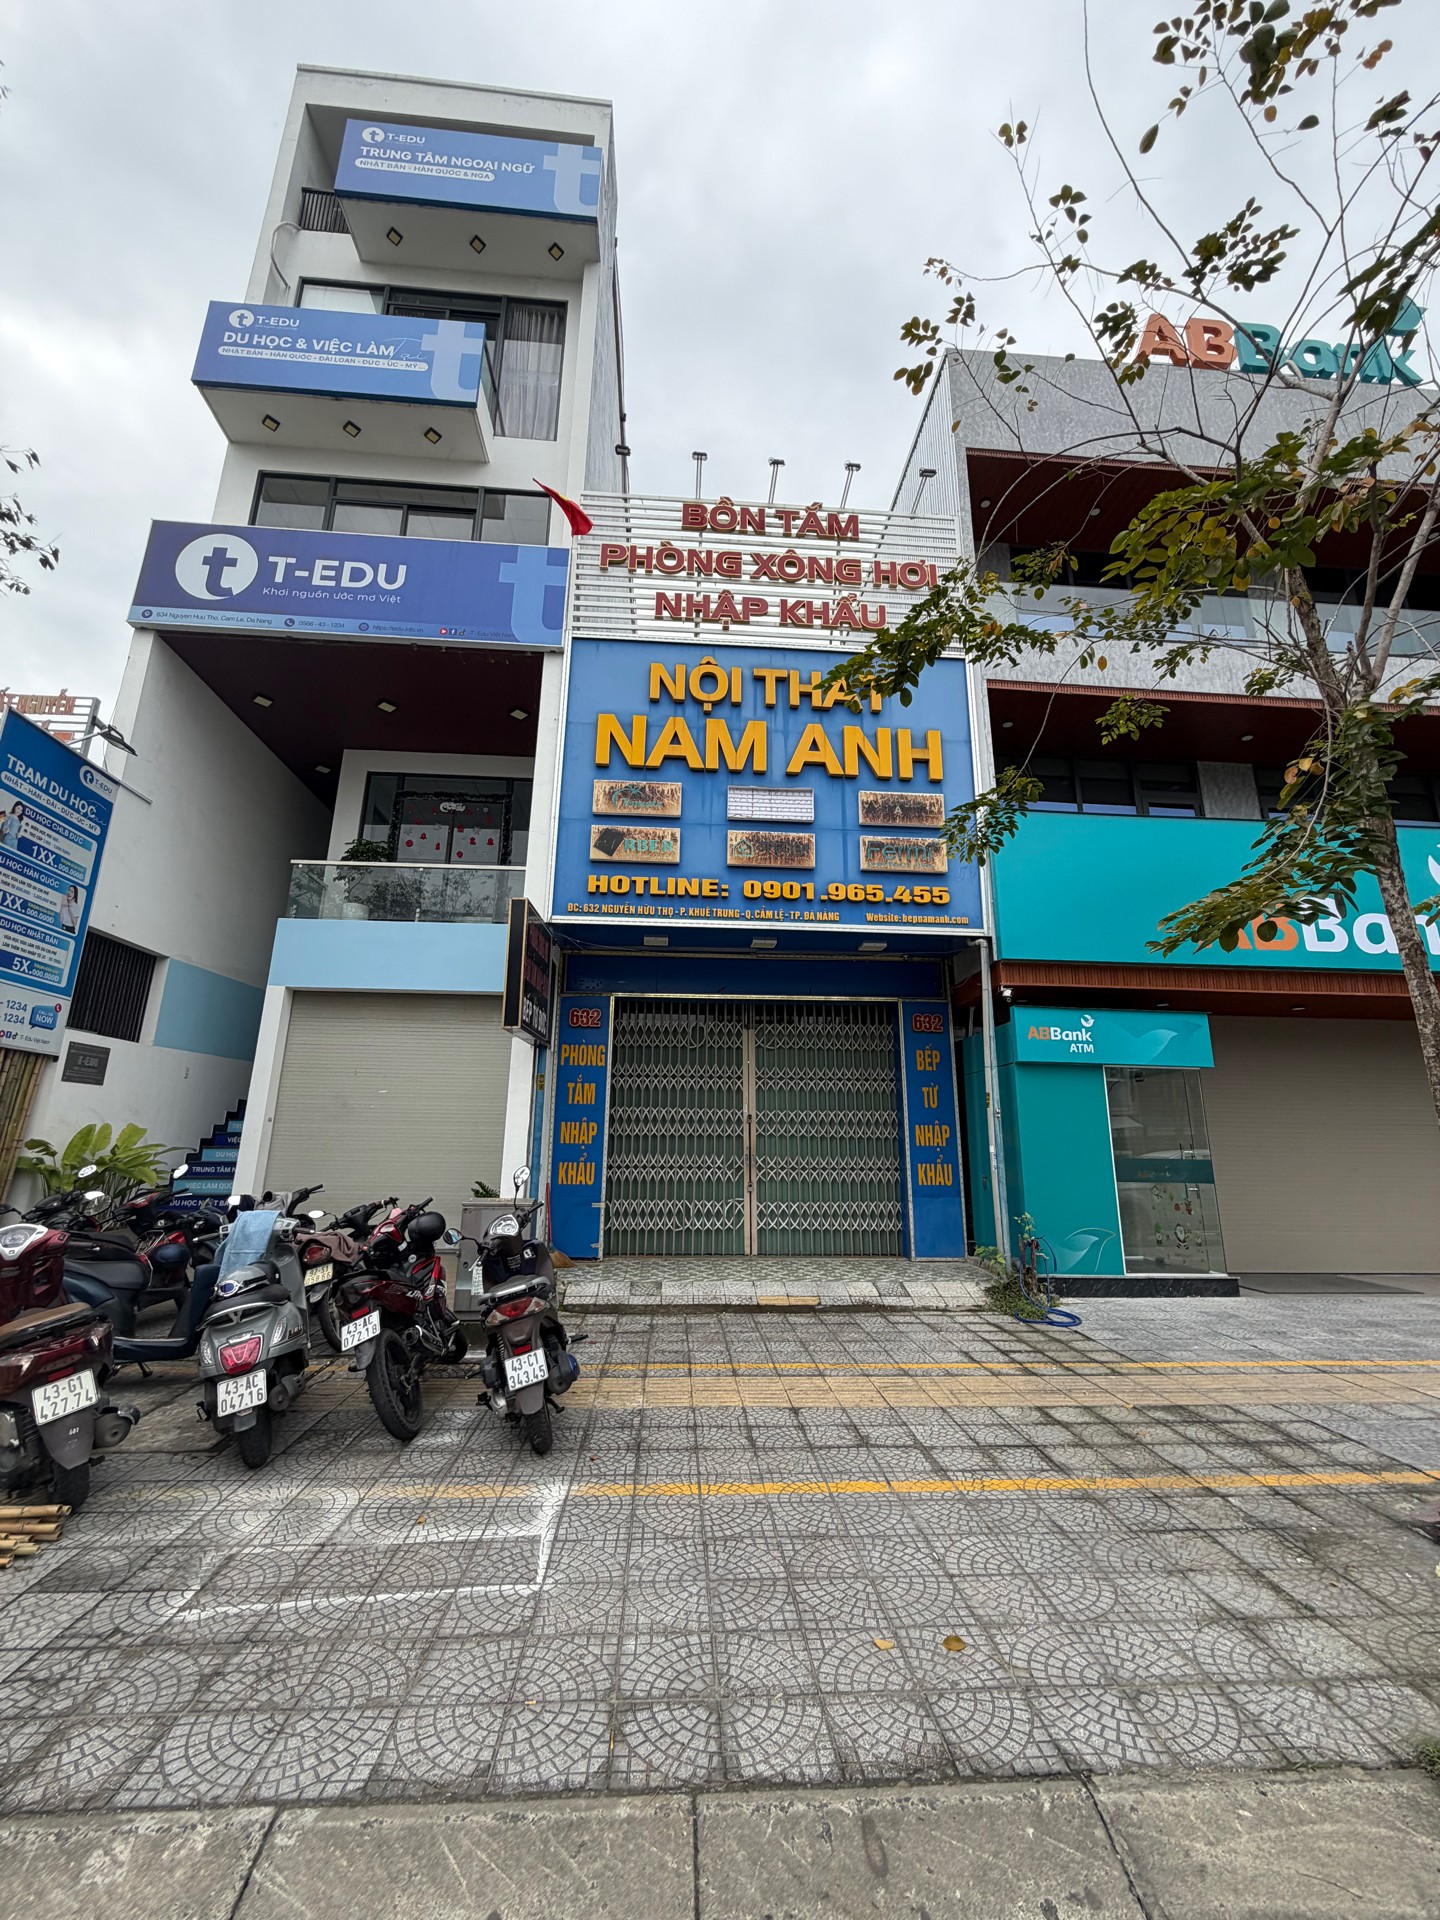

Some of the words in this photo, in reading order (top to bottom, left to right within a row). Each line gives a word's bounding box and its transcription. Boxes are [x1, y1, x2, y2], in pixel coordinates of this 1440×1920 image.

[387, 133, 426, 144] T-EDU
[360, 146, 412, 161] TRUNG
[416, 151, 446, 164] TÂM
[450, 156, 498, 171] NGOẠI
[501, 162, 535, 174] NGỮ
[413, 166, 433, 174] HÀN
[435, 168, 461, 176] QUỐC
[471, 172, 490, 180] NGA
[256, 315, 300, 327] T-EDU
[223, 331, 250, 344] DU
[252, 334, 292, 349] HỌC
[295, 338, 308, 350] &
[312, 337, 352, 354] VIỆC
[356, 340, 395, 356] LÀM
[1134, 312, 1425, 387] ABBank
[268, 556, 407, 590] T-EDU
[600, 540, 743, 579] PHÒNG
[750, 549, 862, 586] XÔNG
[872, 559, 938, 590] HƠI
[379, 594, 401, 604] Việt
[654, 589, 768, 630] NHẬP
[779, 593, 887, 630] KHẨU
[169, 612, 192, 620] Nguyen
[650, 655, 741, 714] NỘI
[596, 713, 767, 774] NAM
[786, 723, 943, 782] ANH
[7, 753, 48, 790] TRẠM
[49, 781, 69, 801] DU
[70, 793, 97, 818] HỌC
[28, 787, 43, 801] HÀN
[94, 779, 113, 794] T-EDU
[25, 809, 36, 819] DU
[36, 814, 51, 828] HỌC
[52, 823, 69, 837] CHLB
[69, 831, 84, 845] ĐỨC
[867, 841, 932, 862] Fermi
[6, 859, 23, 871] HỌC
[23, 867, 40, 879] HÀN
[40, 874, 60, 889] QUỐC
[587, 875, 729, 898] HOTLINE:
[743, 880, 951, 905] 0901.965.455
[584, 903, 600, 913] 632
[657, 907, 674, 918] THỌ
[680, 908, 688, 916] P.
[713, 908, 740, 918] TRUNG
[745, 910, 754, 920] Q.
[774, 908, 785, 921] LỆ
[790, 911, 803, 920] TP.
[866, 912, 901, 922] Website:
[902, 914, 969, 924] bepnamanh.com
[0, 919, 11, 928] DU
[11, 923, 27, 934] HỌC
[6, 1000, 28, 1012] 1234
[570, 1009, 601, 1027] 632
[3, 1013, 25, 1025] 1234
[35, 1014, 54, 1025] NOW
[912, 1014, 943, 1032] 632
[1028, 1026, 1093, 1042] ABBank
[561, 1040, 606, 1066] PHÒNG
[916, 1043, 941, 1071] BẾP
[1070, 1043, 1095, 1053] ATM
[567, 1075, 596, 1105] TẮM
[560, 1118, 597, 1150] NHẬP
[915, 1121, 950, 1151] NHẬP
[217, 1165, 231, 1173] TÂM
[558, 1153, 595, 1184] KHẨU
[918, 1154, 953, 1186] KHẨU
[343, 1323, 377, 1348] 072.18
[346, 1314, 374, 1335] 43-AC
[511, 1352, 539, 1372] 43-C1
[43, 1375, 84, 1402] 43-G1
[225, 1374, 258, 1396] 43-AC
[509, 1364, 546, 1389] 343.45
[40, 1389, 93, 1420] 427.74
[220, 1388, 264, 1413] 047.16
